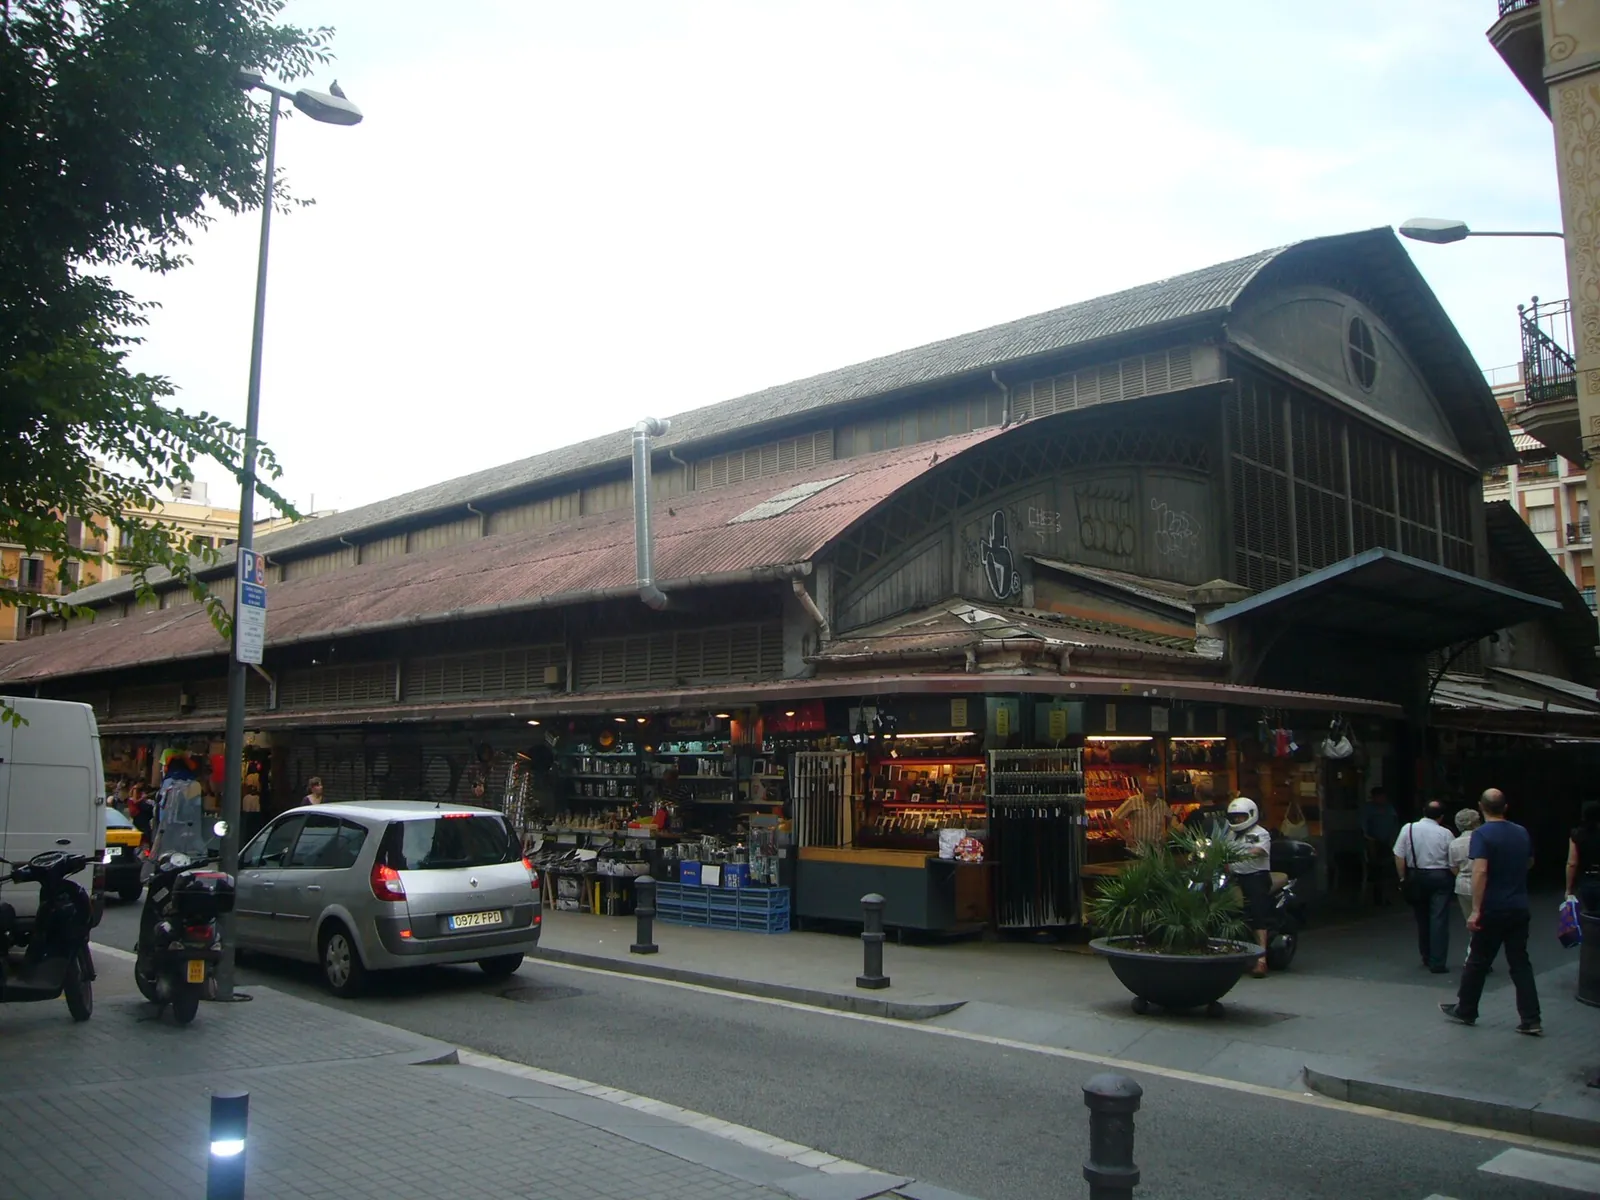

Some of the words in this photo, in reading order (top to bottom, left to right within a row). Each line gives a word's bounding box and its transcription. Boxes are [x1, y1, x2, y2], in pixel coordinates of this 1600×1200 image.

[244, 553, 253, 579] P
[455, 914, 480, 927] 0972
[482, 911, 500, 924] FPD
